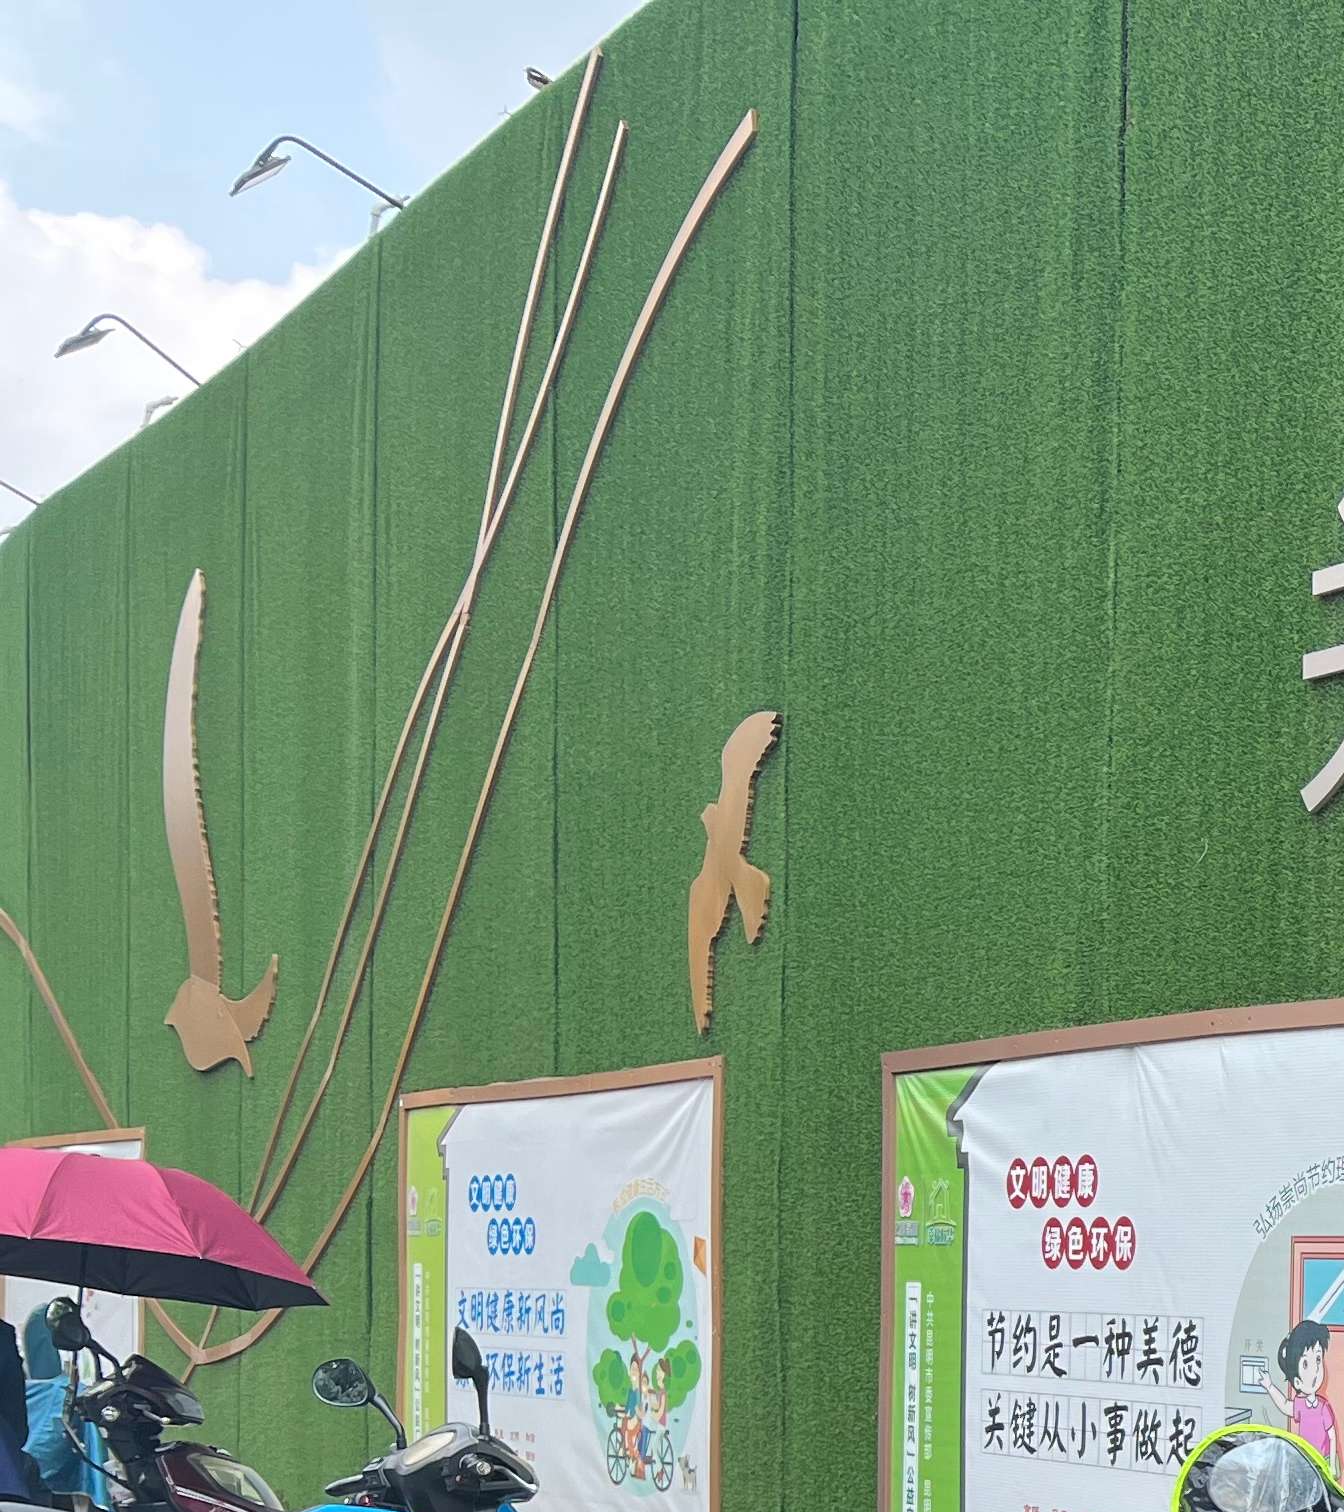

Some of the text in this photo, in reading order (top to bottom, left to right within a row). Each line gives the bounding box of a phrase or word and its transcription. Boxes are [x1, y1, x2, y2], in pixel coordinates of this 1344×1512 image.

[469, 1176, 516, 1210] 文明健康
[1009, 1160, 1096, 1203] 文明健康
[488, 1219, 535, 1254] 绿色环保
[1044, 1223, 1133, 1264] 绿色环保
[456, 1288, 564, 1335] 文明健康新风尚
[987, 1311, 1202, 1387] 节约是一种美德
[455, 1349, 564, 1397] 环保新生活
[984, 1393, 1196, 1466] 关键从小事做起
